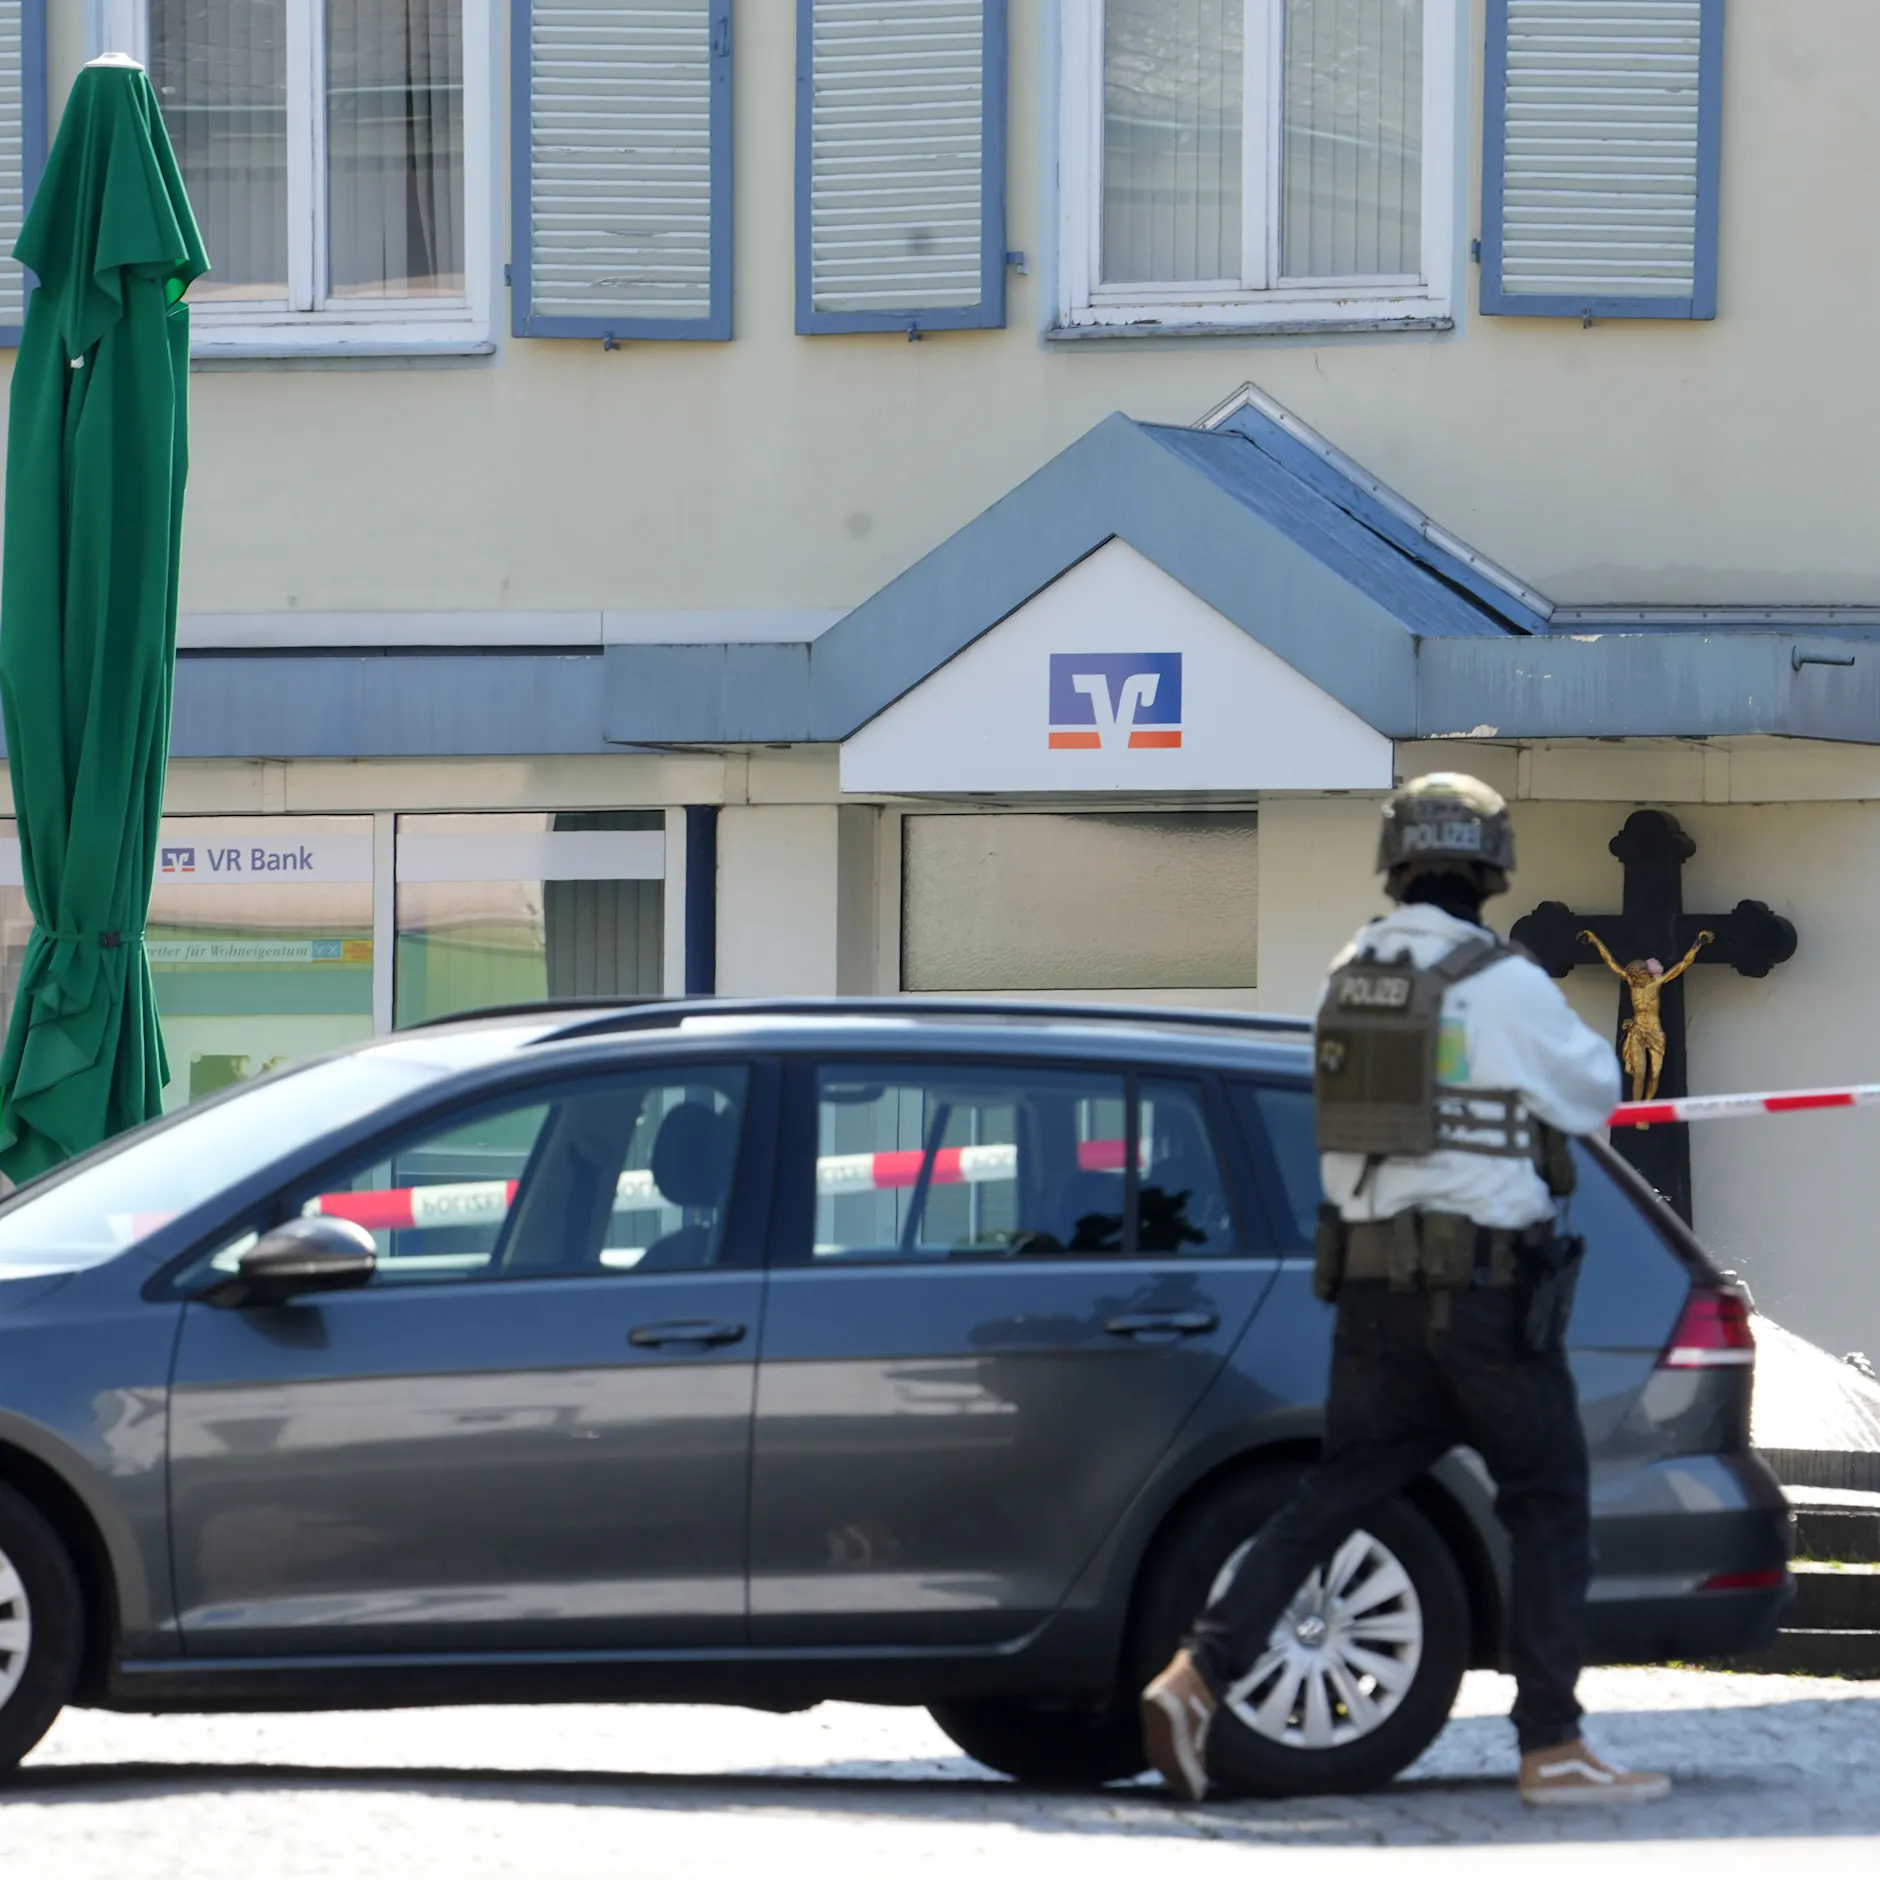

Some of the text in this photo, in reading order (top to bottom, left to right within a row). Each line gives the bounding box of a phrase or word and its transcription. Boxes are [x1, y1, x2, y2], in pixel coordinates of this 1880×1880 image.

[1403, 822, 1481, 850] POLIZEI
[207, 846, 314, 871] VR Bank
[185, 944, 207, 960] für
[210, 944, 308, 960] Wohneigentum
[1341, 977, 1411, 1005] POLIZEI
